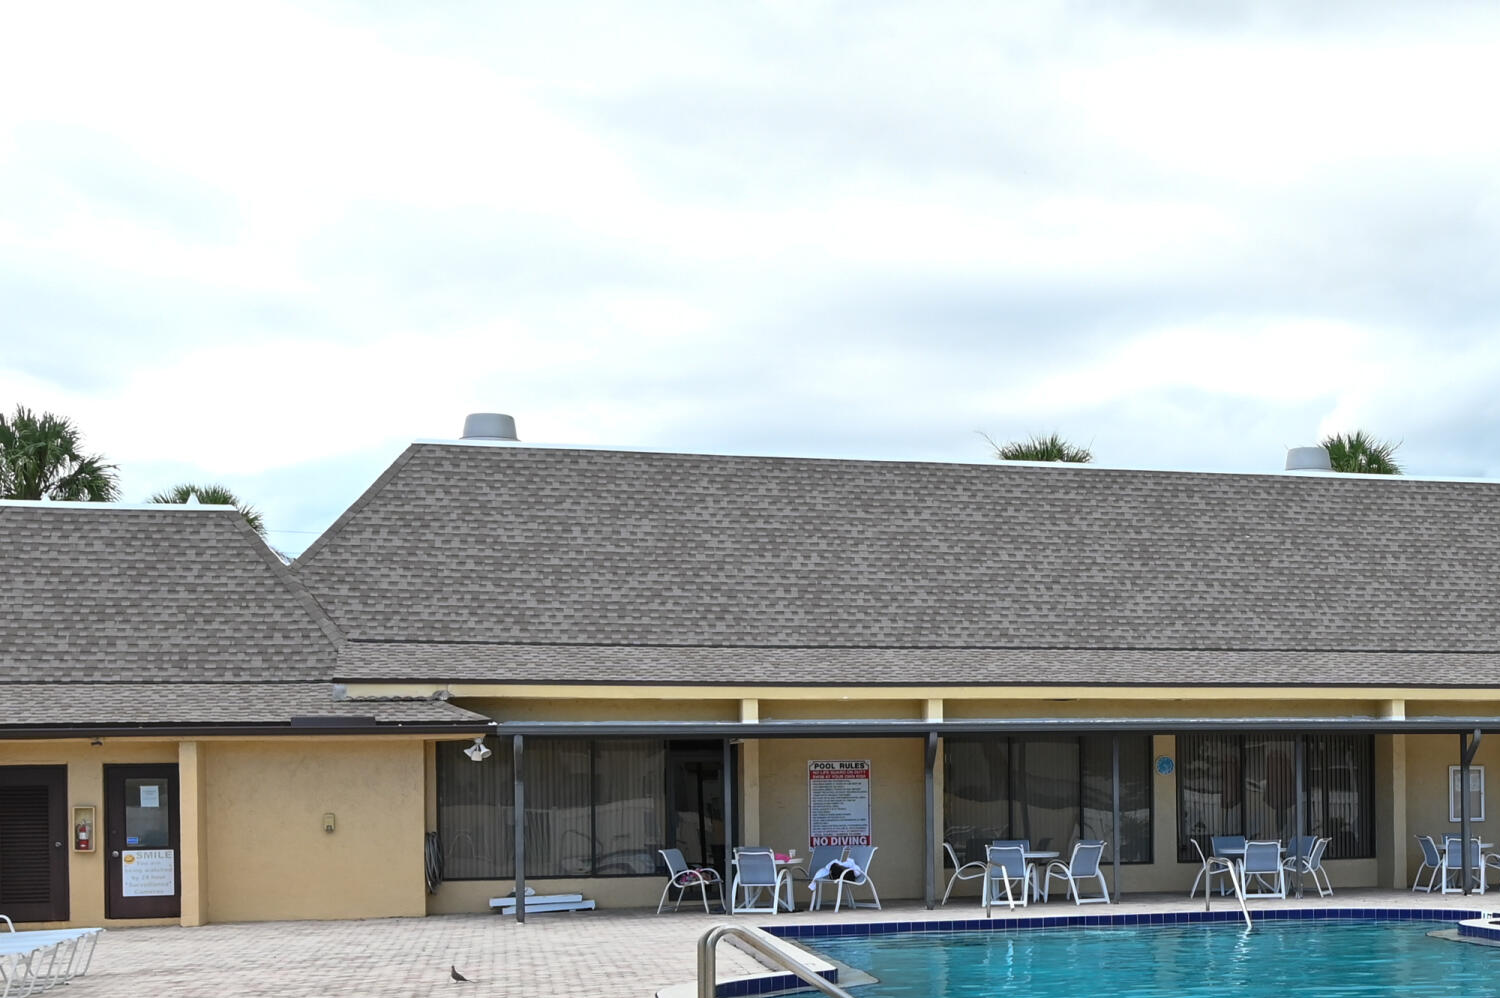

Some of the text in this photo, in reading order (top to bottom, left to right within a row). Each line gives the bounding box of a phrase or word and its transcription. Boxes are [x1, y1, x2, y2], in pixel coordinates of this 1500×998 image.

[813, 836, 867, 846] NO DIVING
[136, 851, 172, 859] SMILE
